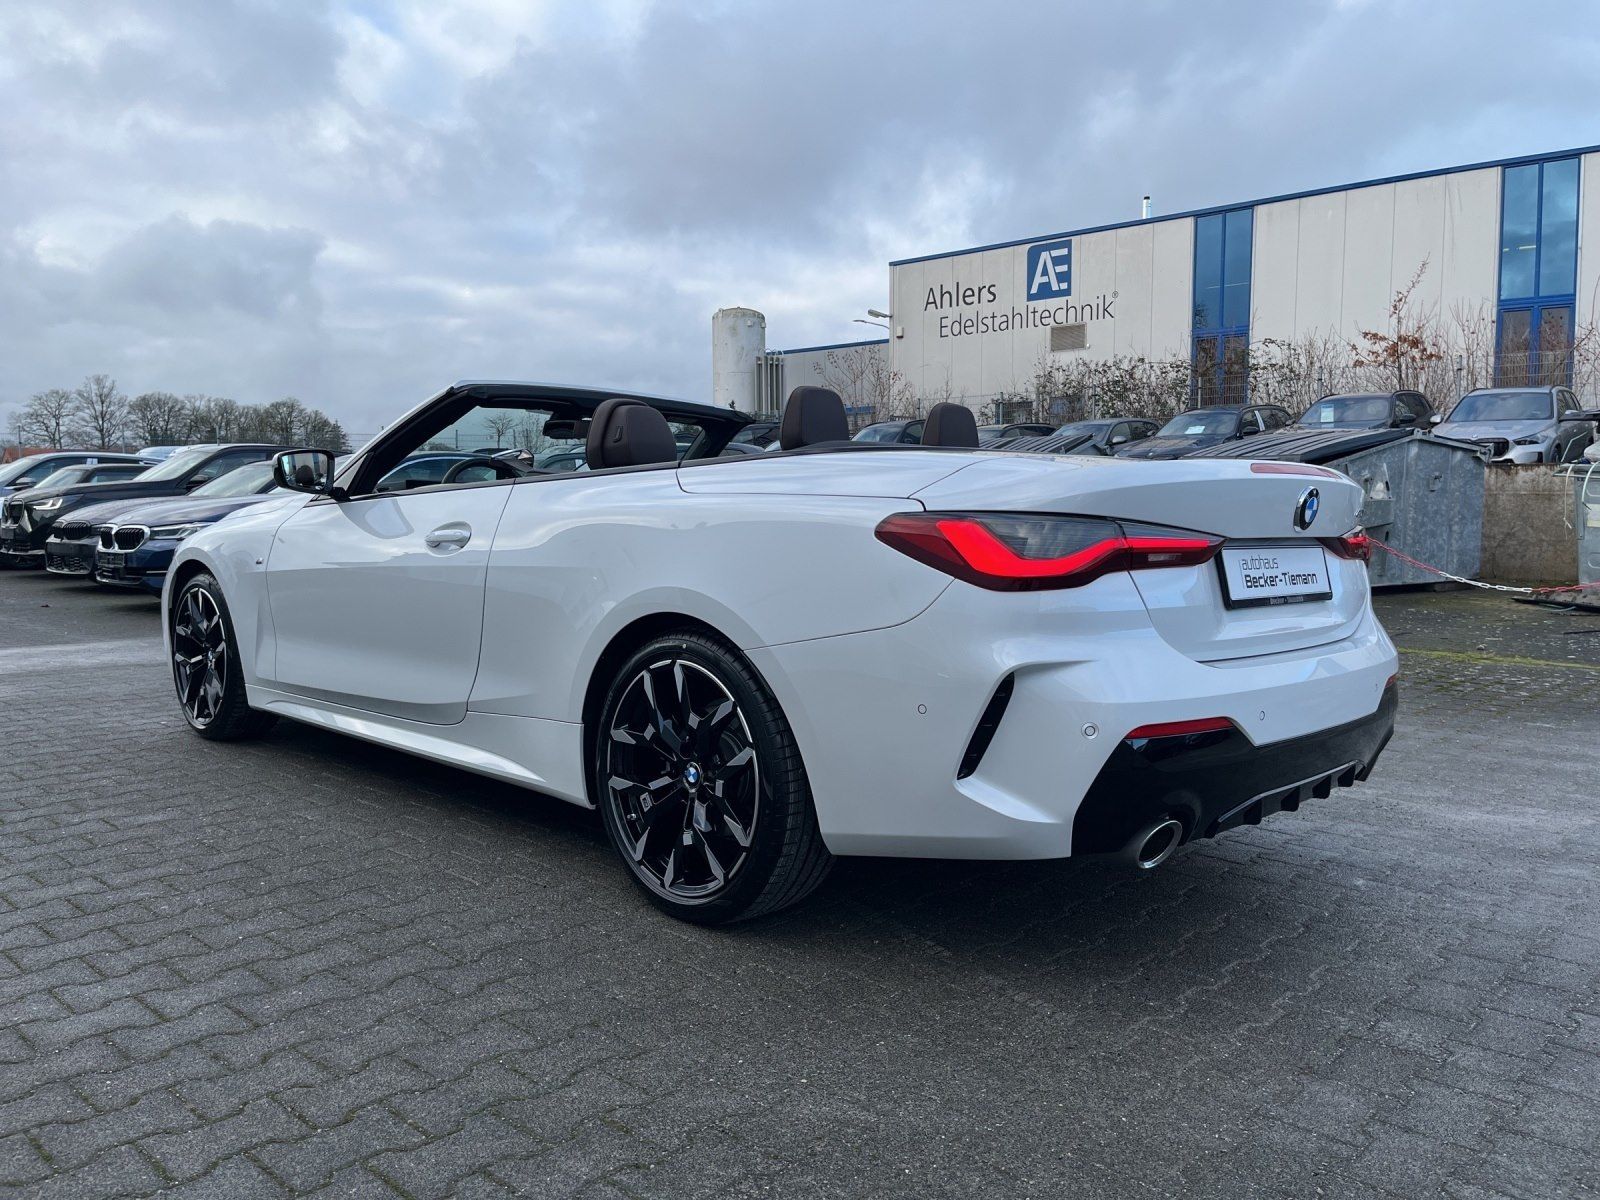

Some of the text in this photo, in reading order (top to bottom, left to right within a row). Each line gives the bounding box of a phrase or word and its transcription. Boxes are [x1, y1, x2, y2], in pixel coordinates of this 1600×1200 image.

[924, 282, 997, 311] Ahlers
[939, 294, 1115, 338] Edelstahltechnik
[1241, 554, 1279, 571] autohaus
[1244, 572, 1318, 589] Becker-Tiemann
